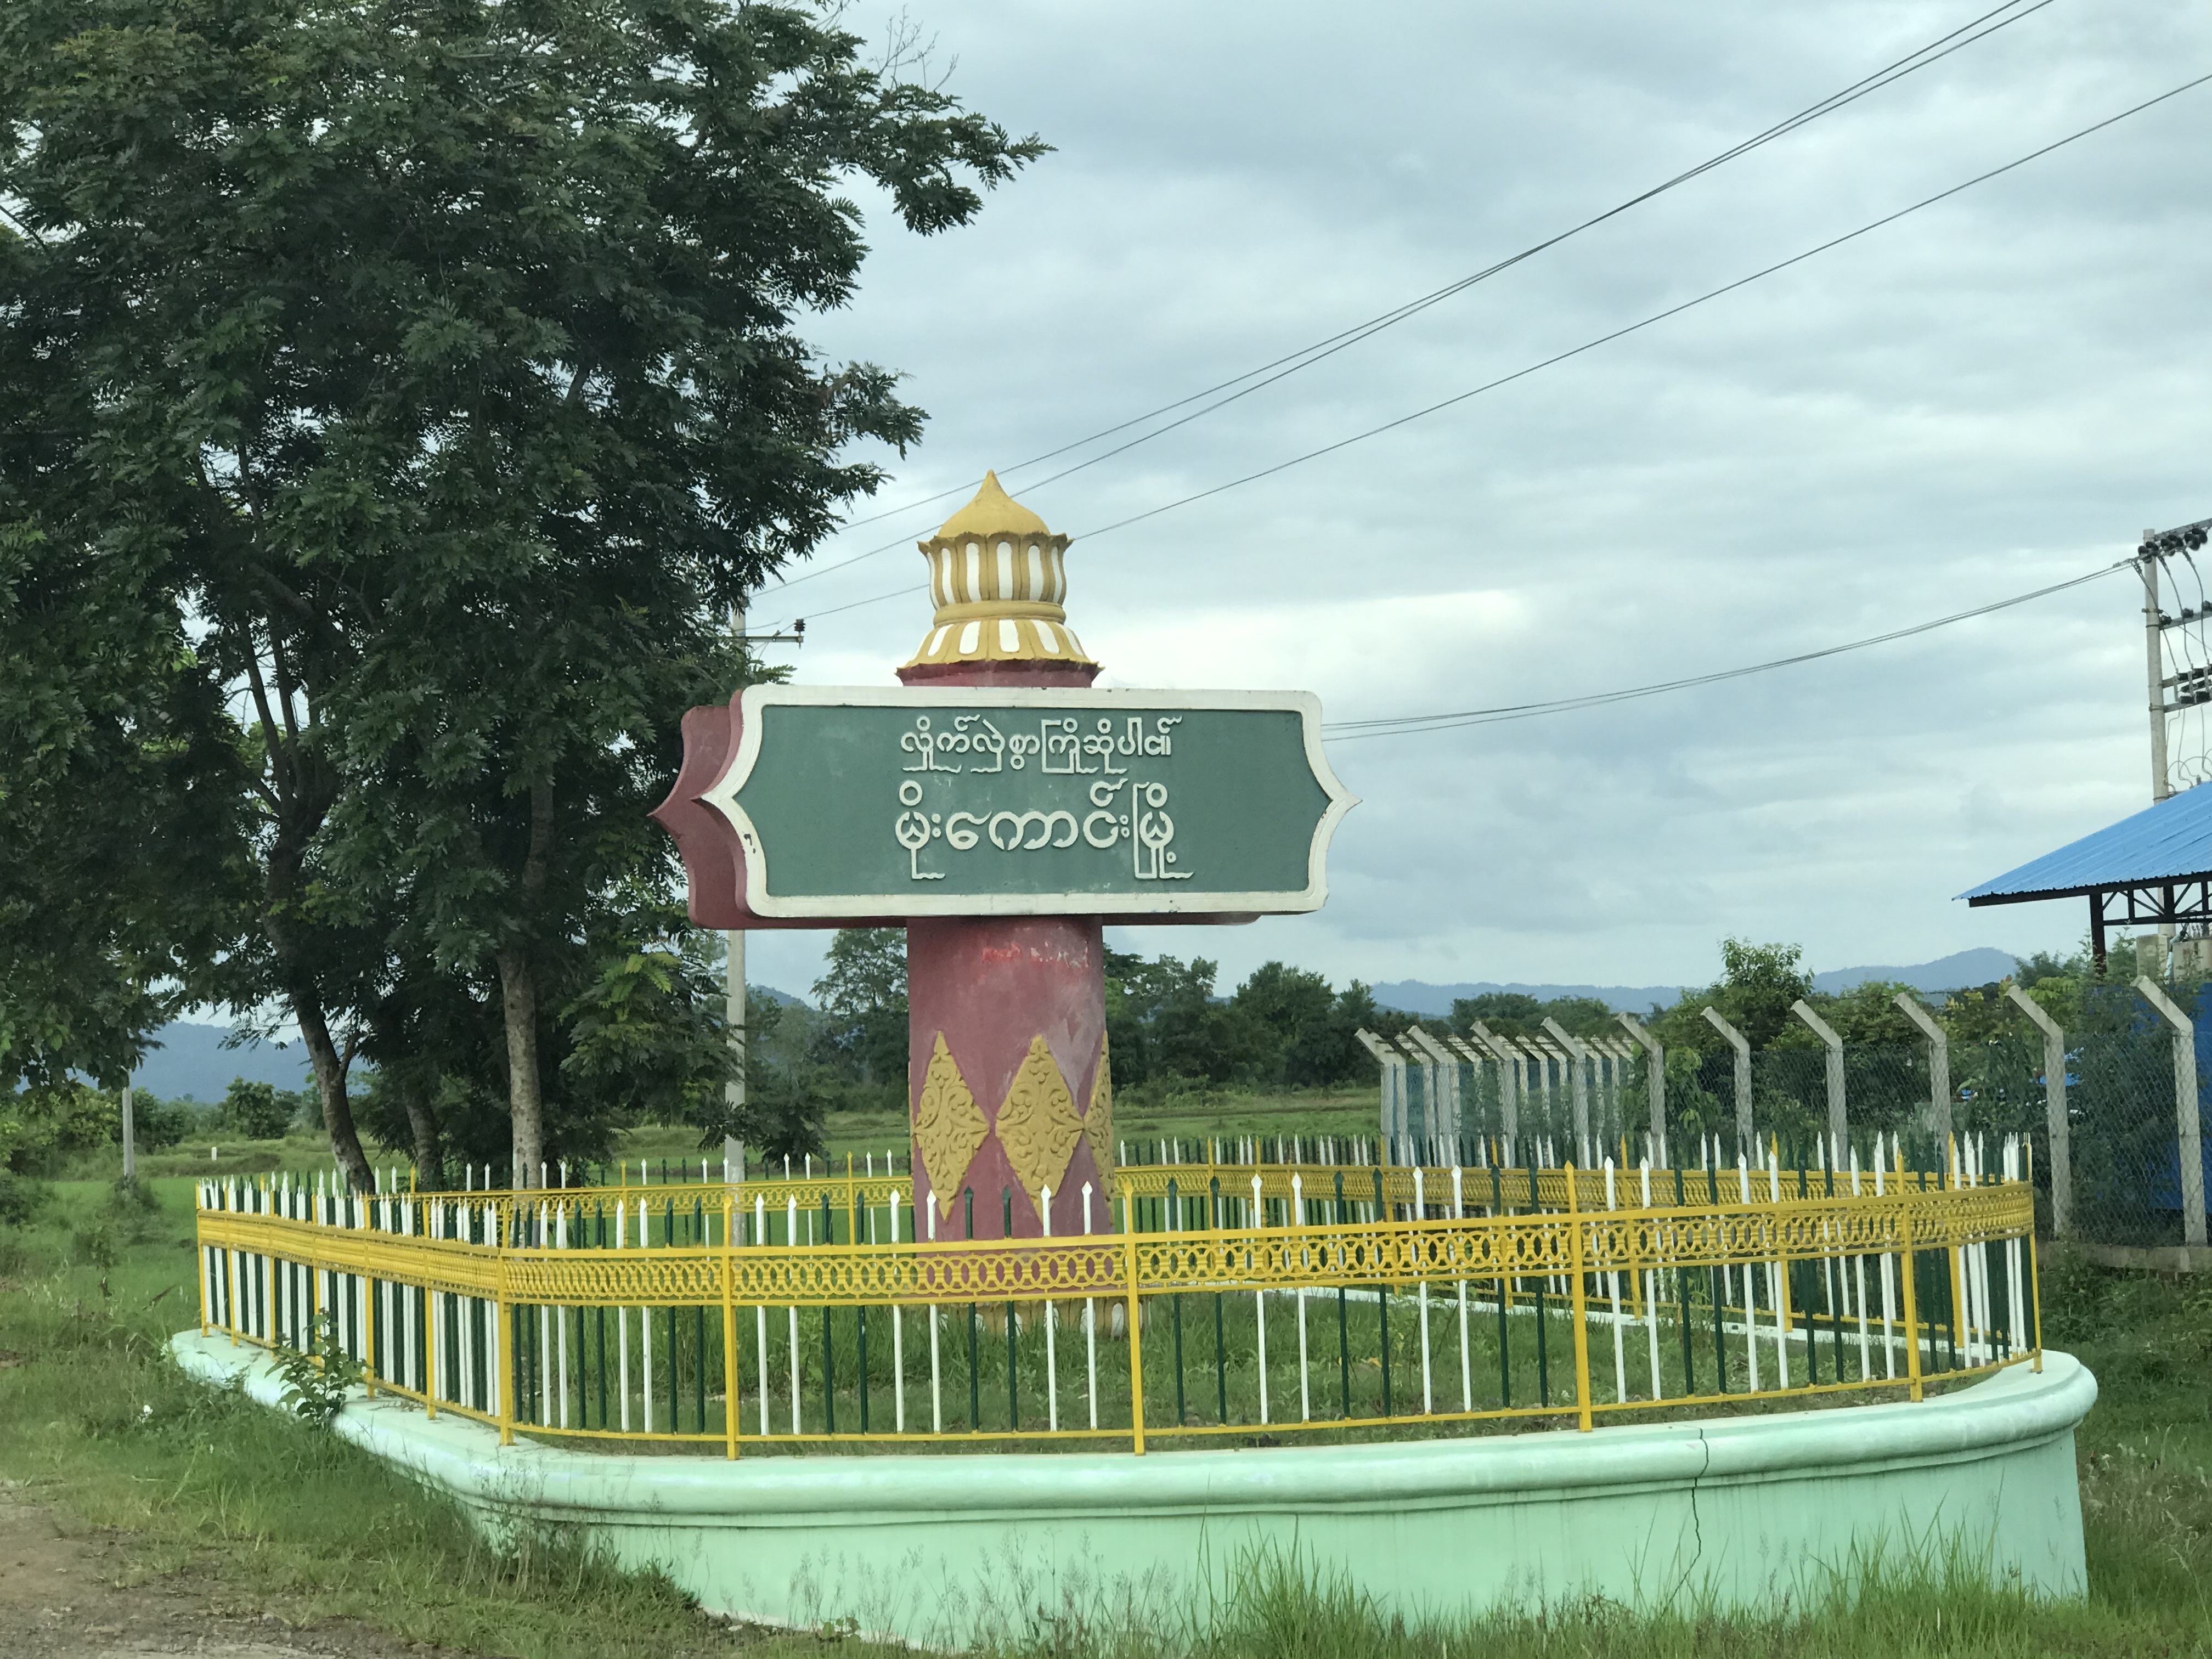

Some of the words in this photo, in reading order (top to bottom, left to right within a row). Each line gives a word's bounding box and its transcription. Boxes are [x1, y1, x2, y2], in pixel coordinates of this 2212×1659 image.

[895, 778, 1194, 879] မိုးကောင်းမြို့
